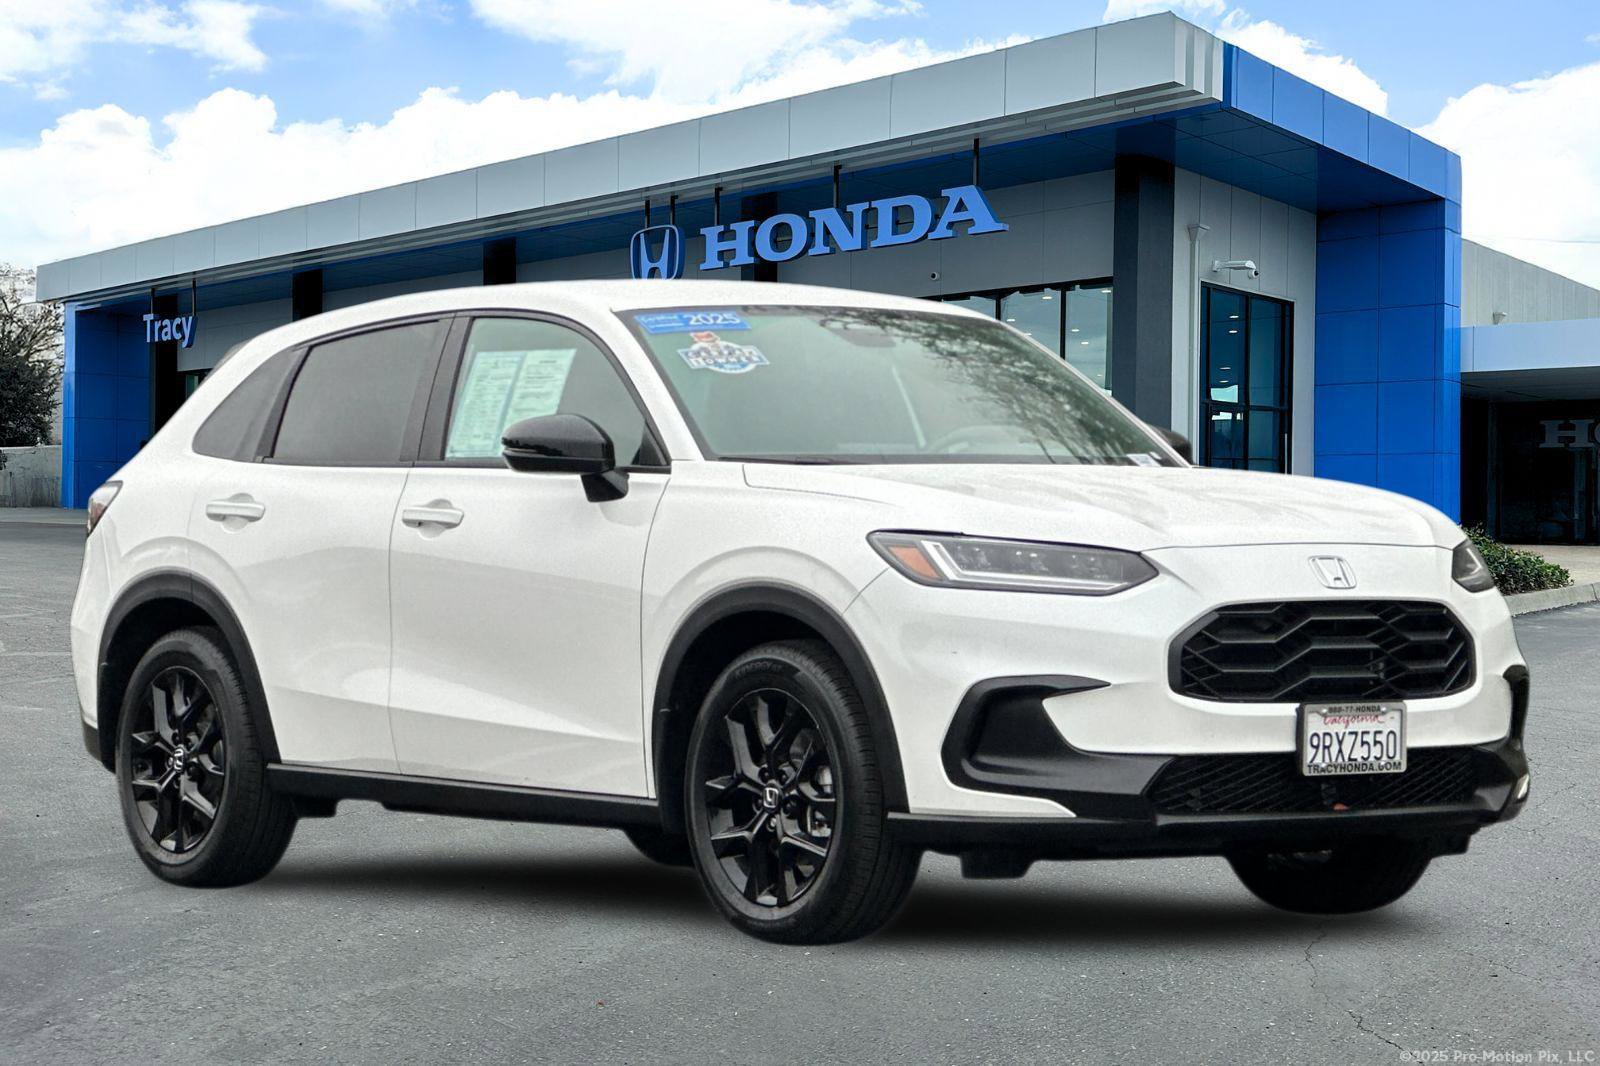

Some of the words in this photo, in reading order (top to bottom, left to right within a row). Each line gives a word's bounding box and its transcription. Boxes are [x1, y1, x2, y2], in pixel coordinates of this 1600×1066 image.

[700, 184, 1009, 271] HONDA
[143, 313, 194, 349] Tracy
[684, 312, 741, 326] 2025
[1309, 730, 1397, 764] 9RXZ550
